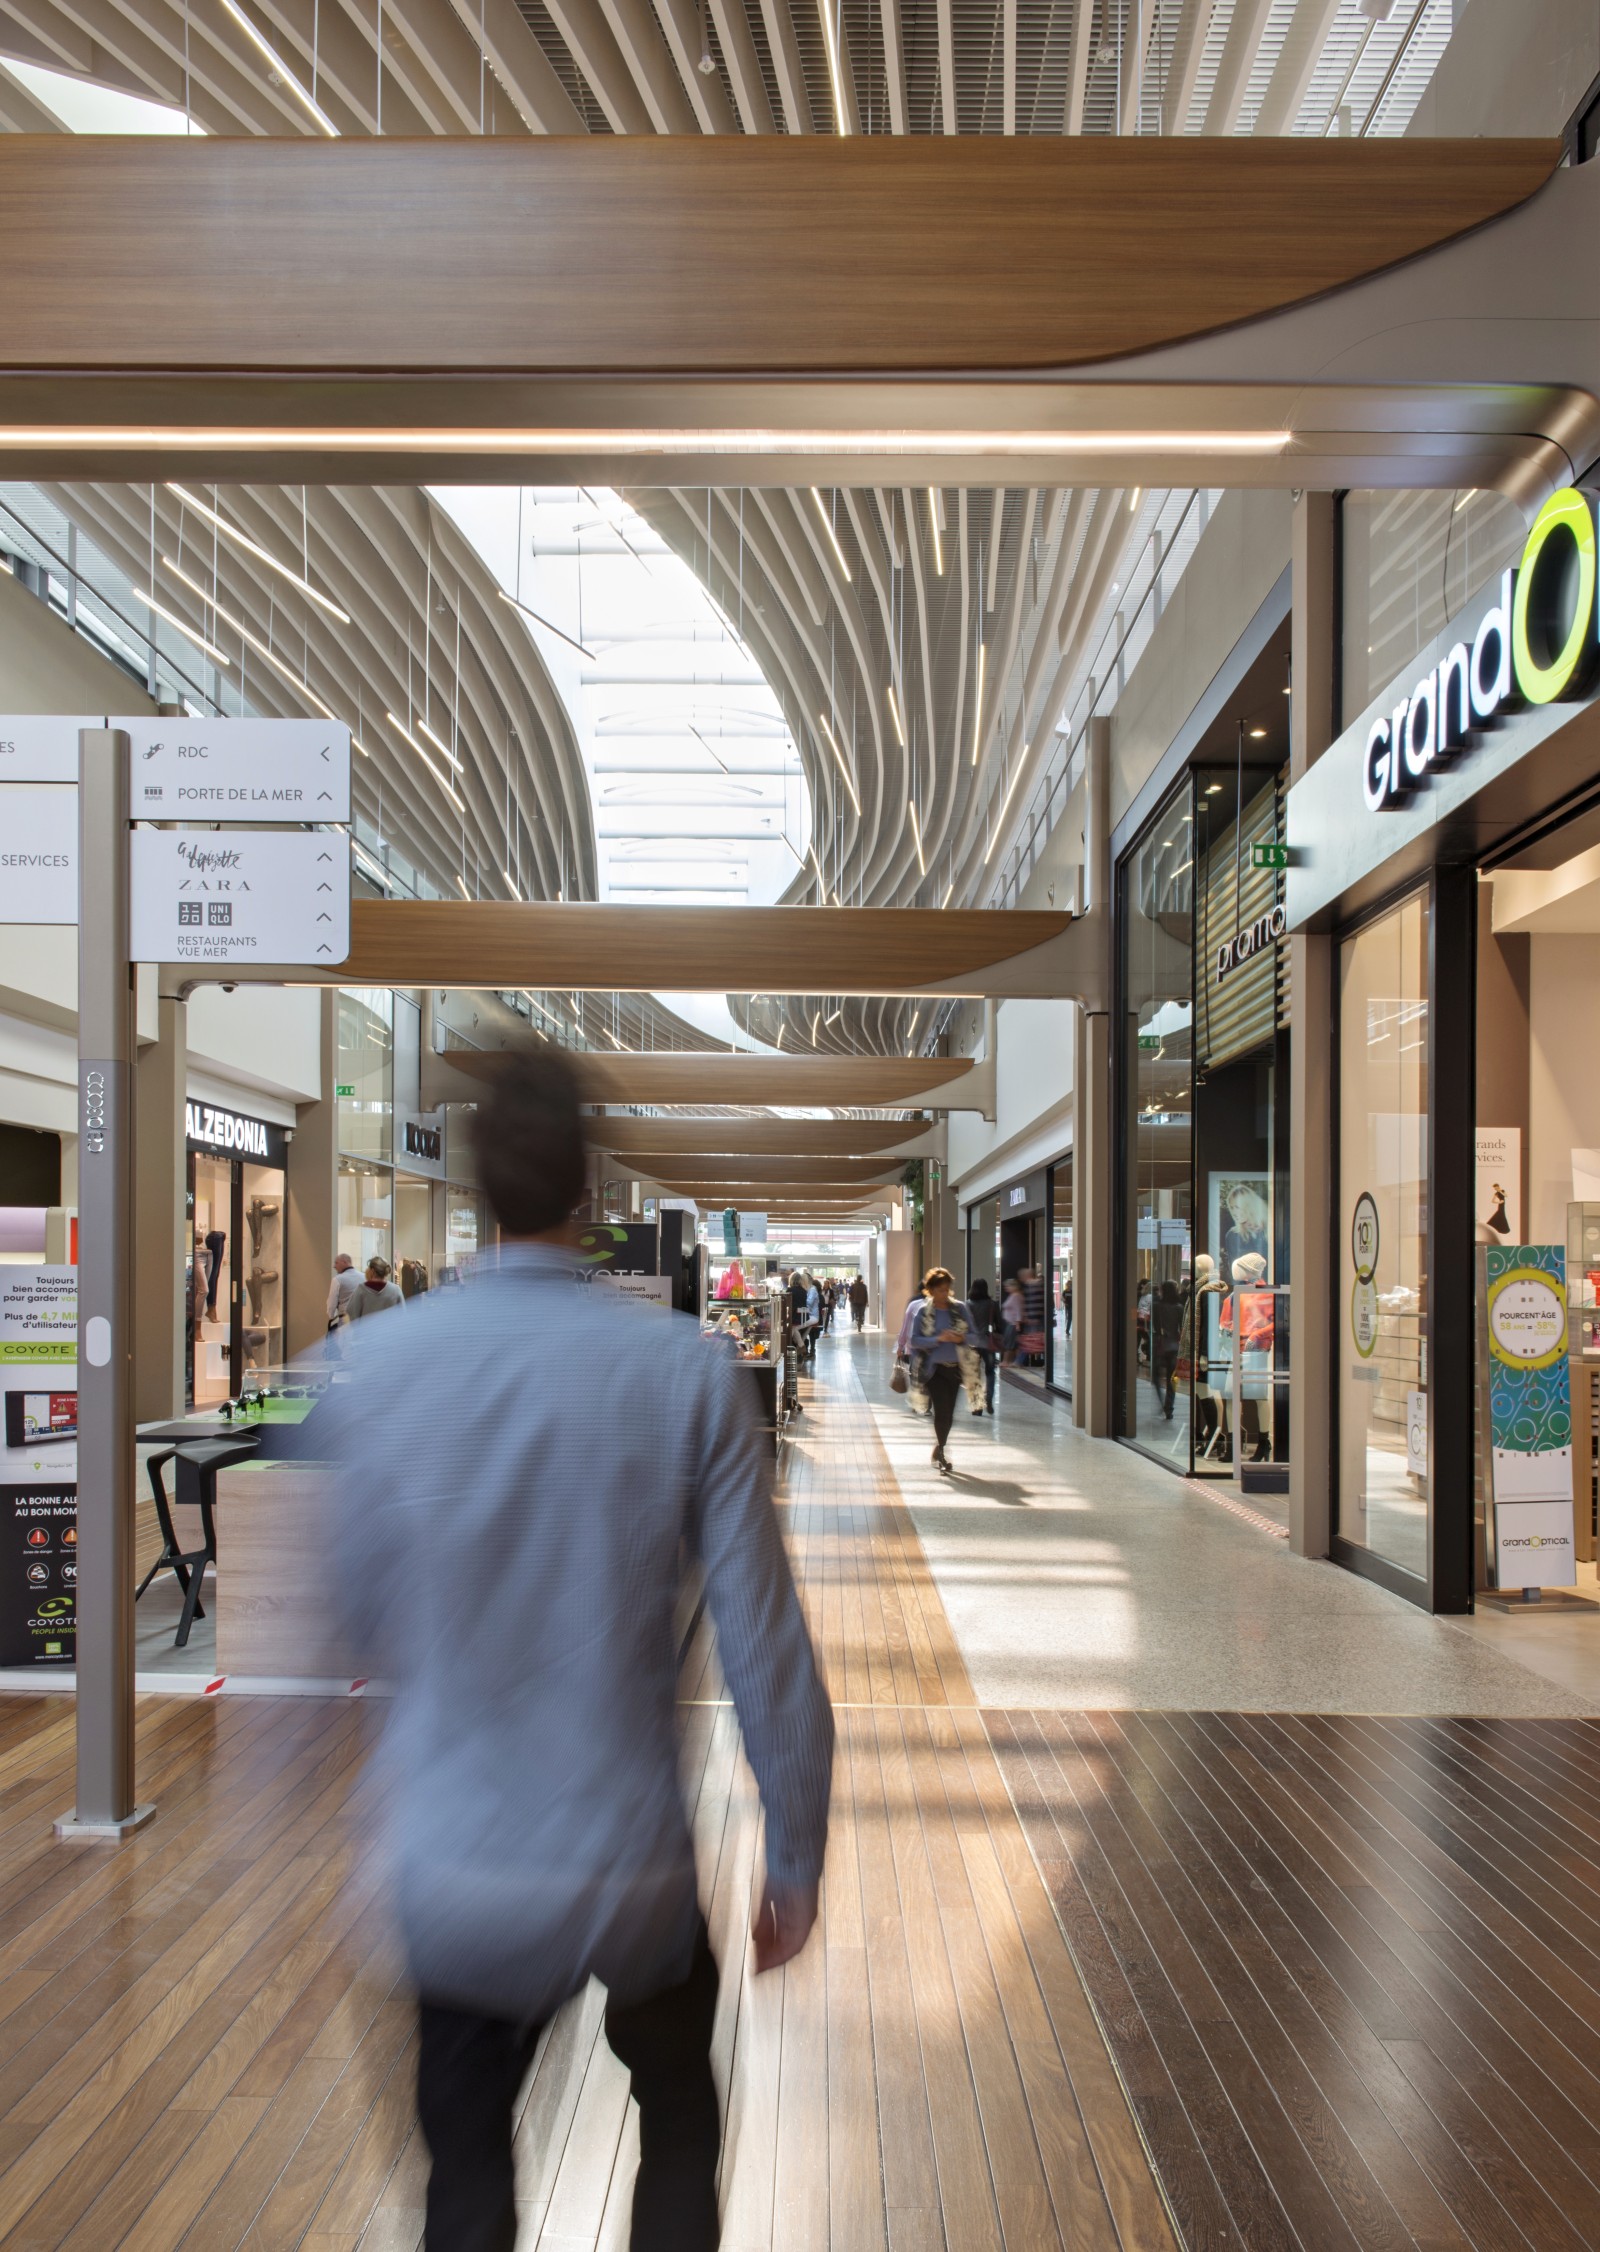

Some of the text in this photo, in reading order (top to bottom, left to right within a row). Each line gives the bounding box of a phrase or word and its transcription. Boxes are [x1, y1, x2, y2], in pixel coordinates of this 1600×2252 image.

[178, 747, 208, 758] RDC
[178, 788, 303, 801] PORTE DE LA MER
[1, 854, 69, 867] SERVICES
[178, 880, 253, 891] ZARA
[177, 936, 257, 947] RESTAURANTS
[1217, 904, 1287, 983] promo
[177, 947, 228, 957] VUE MER
[186, 1103, 268, 1156] ALZEDONIA
[36, 1277, 74, 1285] Toujours
[620, 1286, 646, 1294] Toujours
[27, 1295, 59, 1304] garder
[619, 1292, 662, 1301] accompagné
[4, 1313, 24, 1321] Plus
[26, 1313, 38, 1321] de
[41, 1312, 58, 1321] 4,7
[1499, 1322, 1512, 1331] 58
[4, 1346, 70, 1354] COYOTE
[15, 1497, 27, 1505] LA
[29, 1496, 61, 1505] BONNE
[15, 1508, 29, 1517] AU
[31, 1507, 51, 1516] BON
